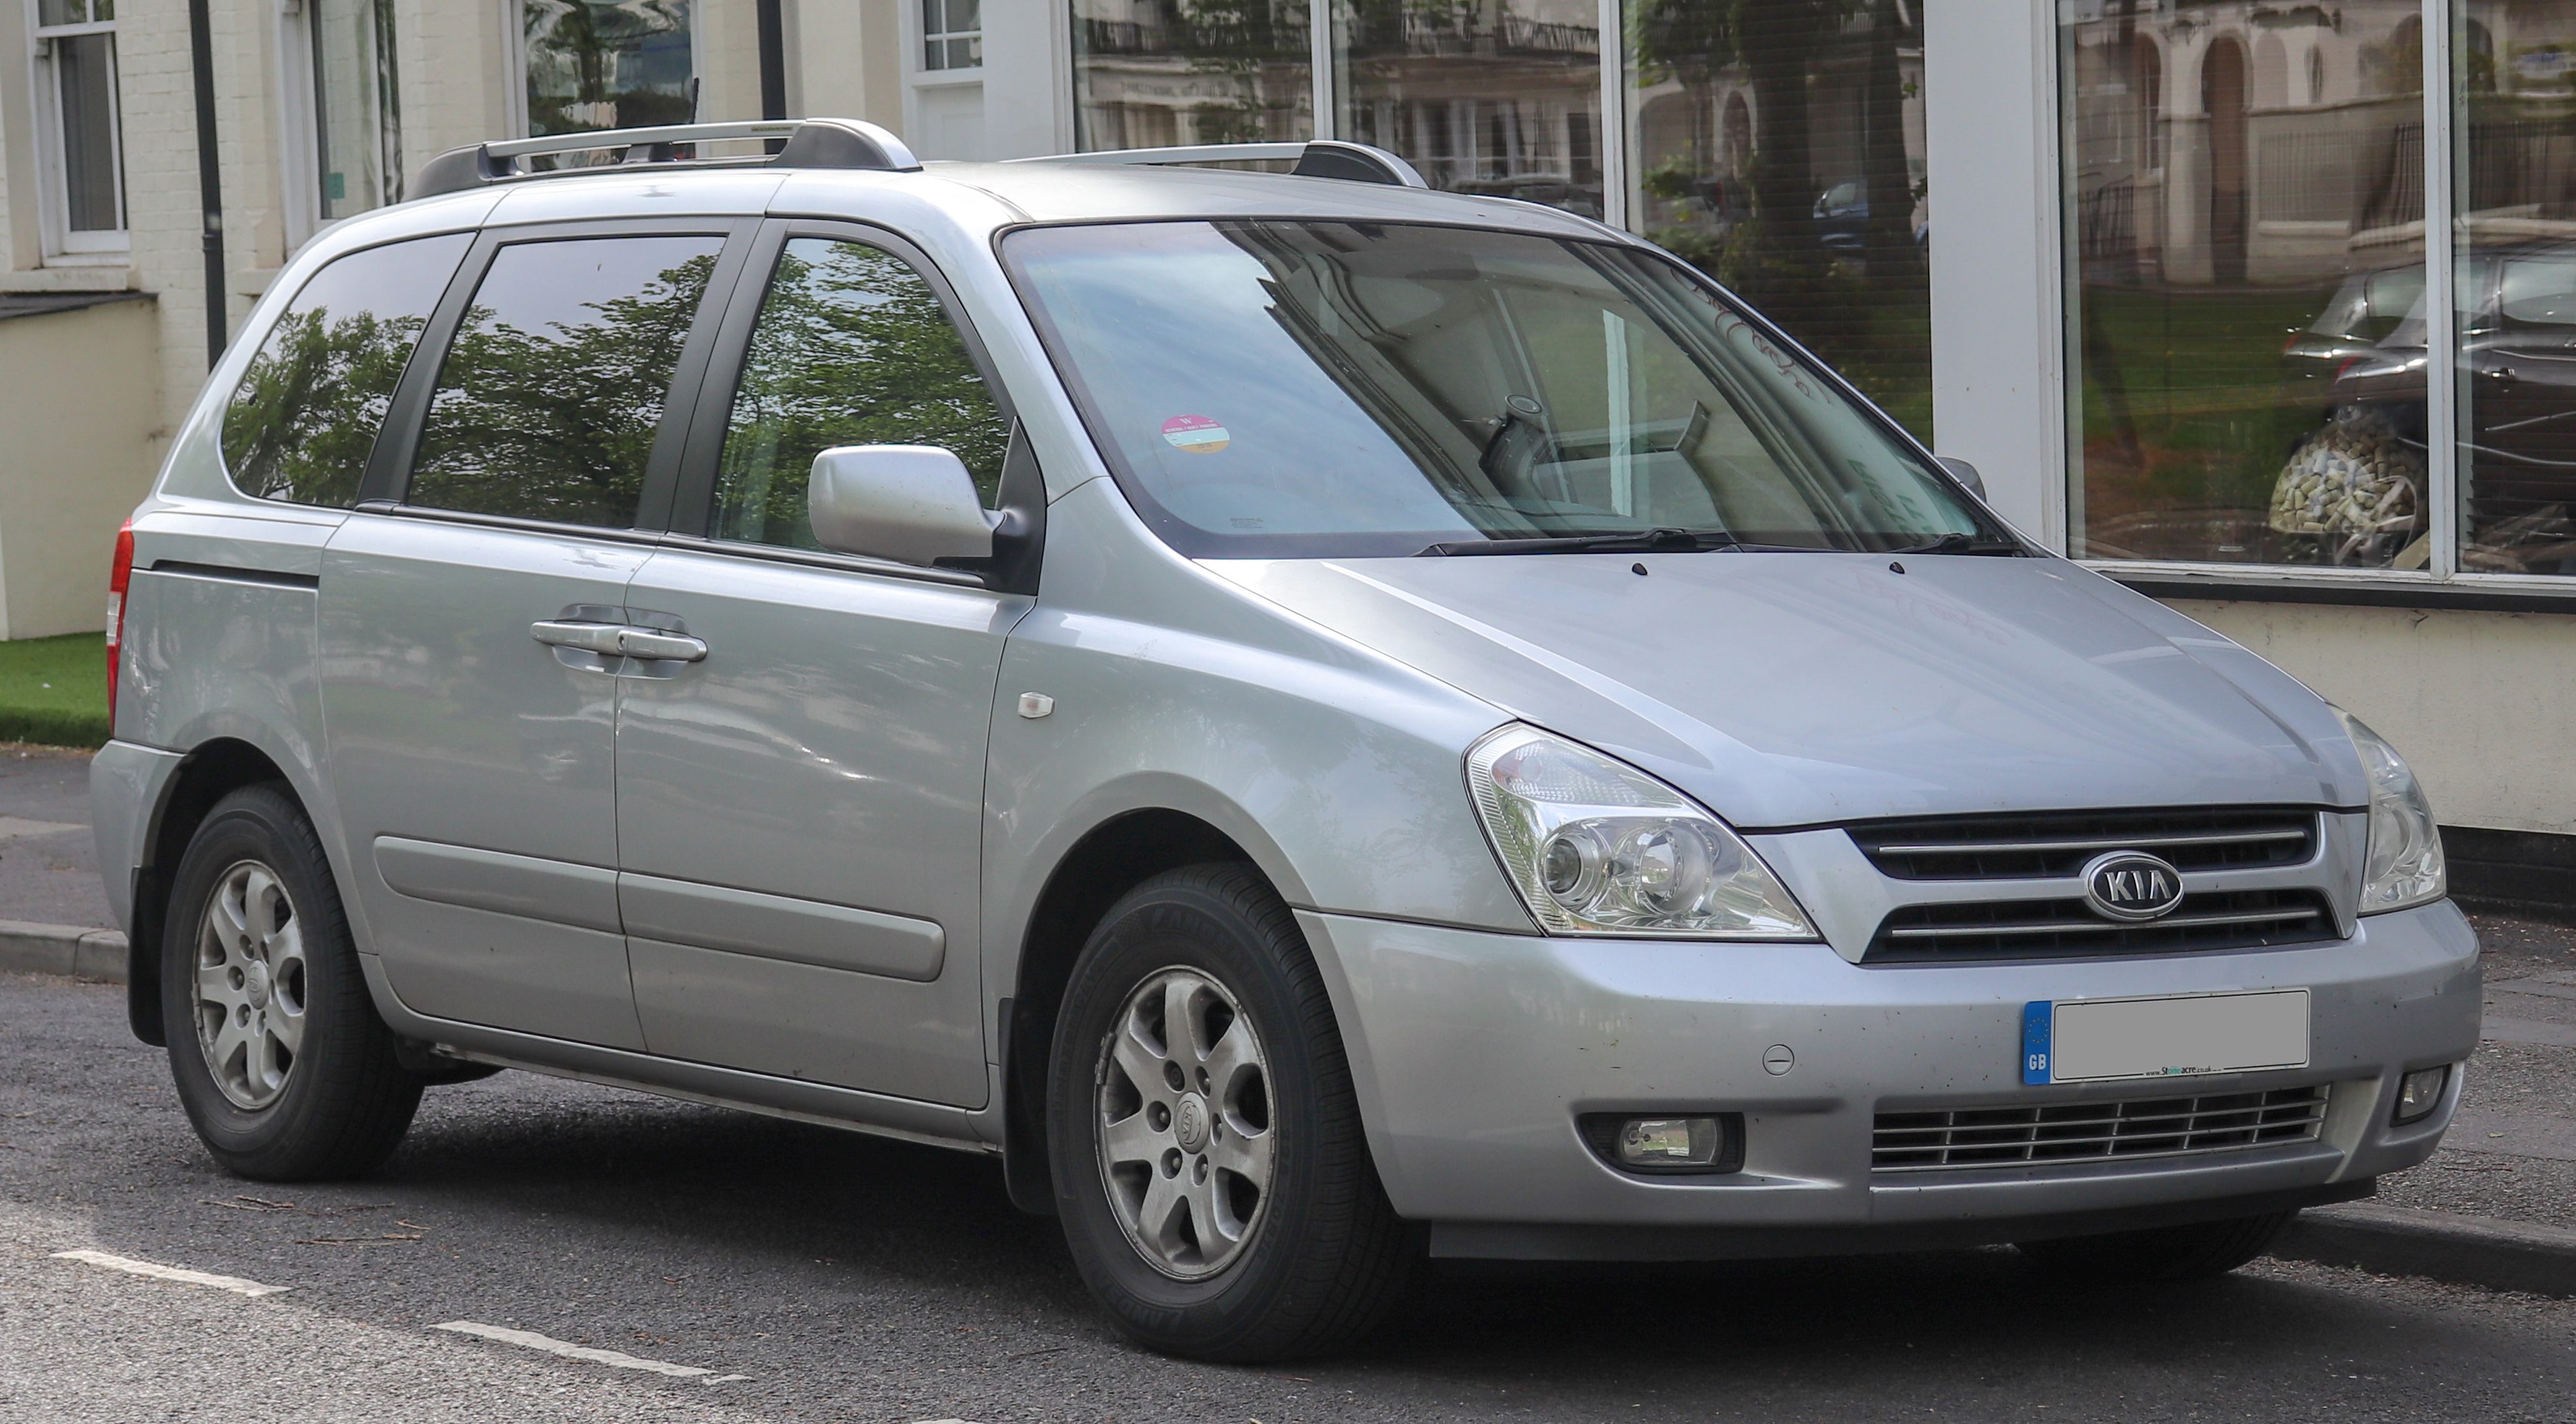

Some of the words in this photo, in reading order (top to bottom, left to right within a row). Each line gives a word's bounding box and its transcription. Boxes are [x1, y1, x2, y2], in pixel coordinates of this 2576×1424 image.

[2104, 870, 2172, 901] KIA
[2029, 1053, 2047, 1070] GB
[1182, 1112, 1193, 1134] KIA
